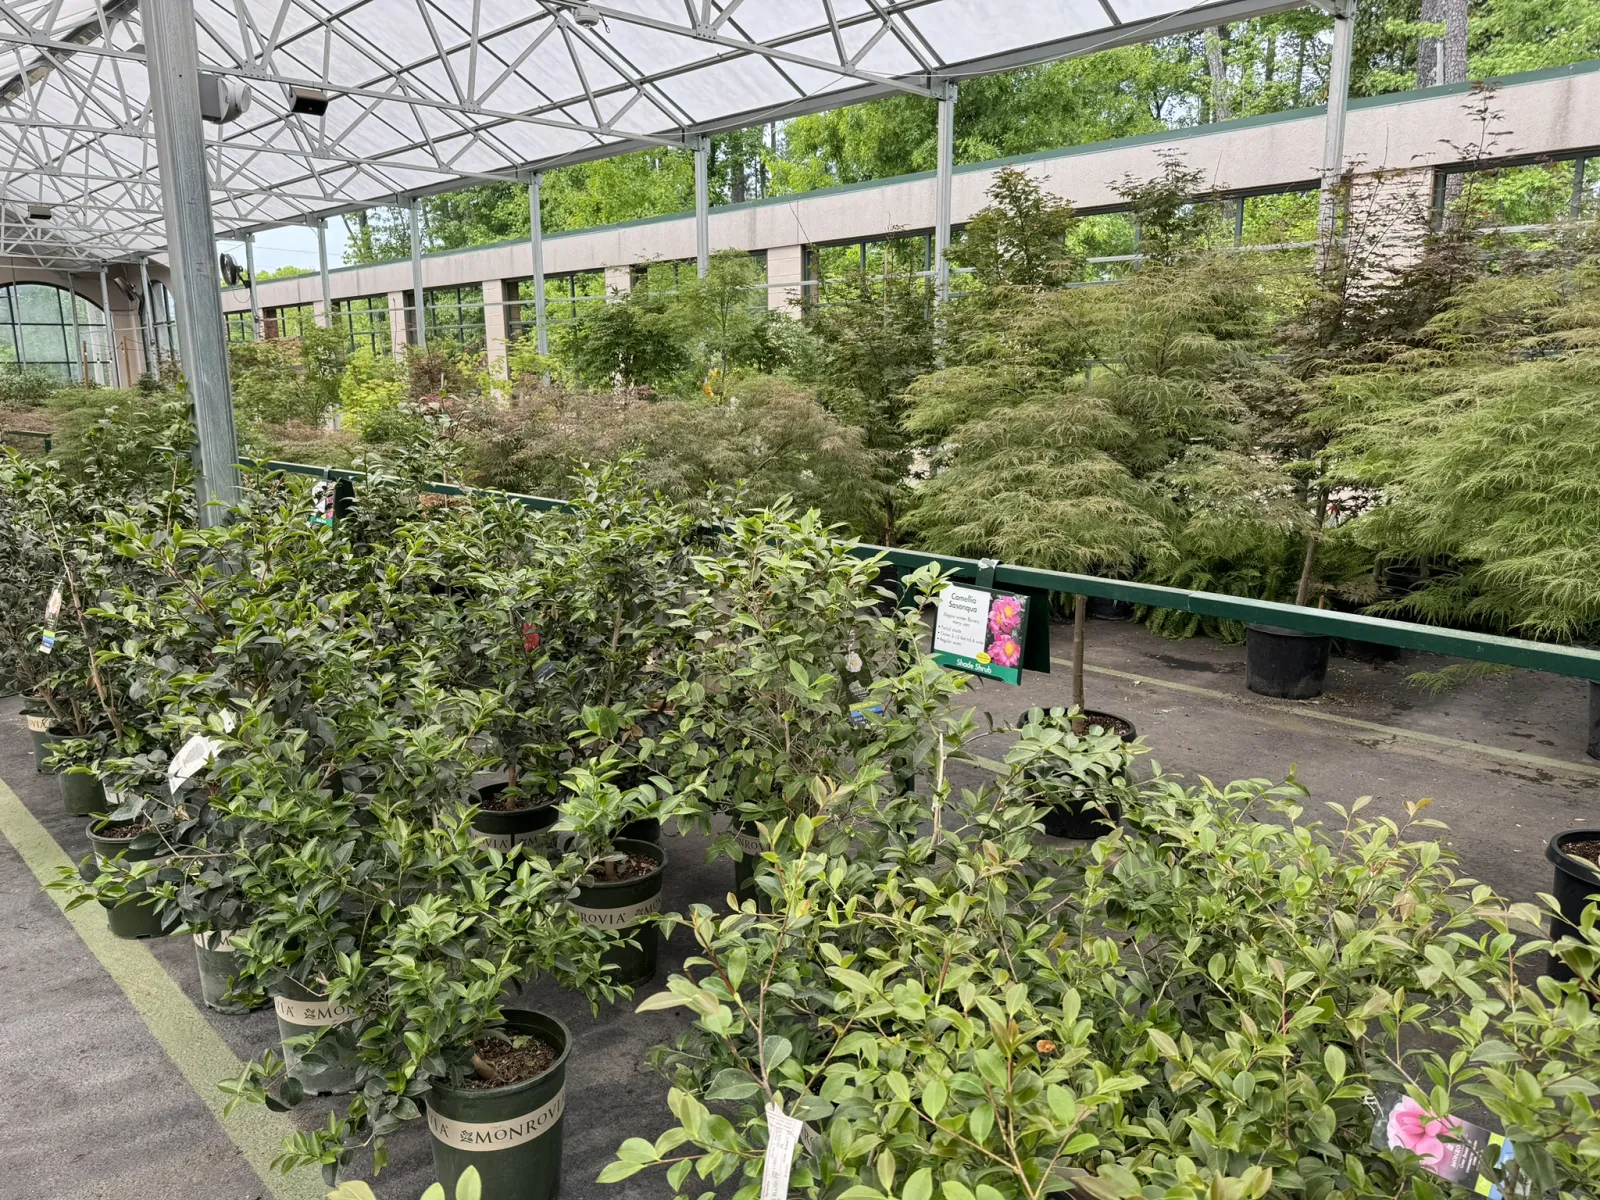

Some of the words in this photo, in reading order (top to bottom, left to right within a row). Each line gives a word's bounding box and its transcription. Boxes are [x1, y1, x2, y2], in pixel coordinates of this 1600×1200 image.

[951, 592, 977, 604] Camellia
[948, 600, 978, 613] Sasanqua
[956, 658, 975, 670] Shade
[974, 663, 993, 674] Shrub
[577, 911, 625, 925] ROVIA
